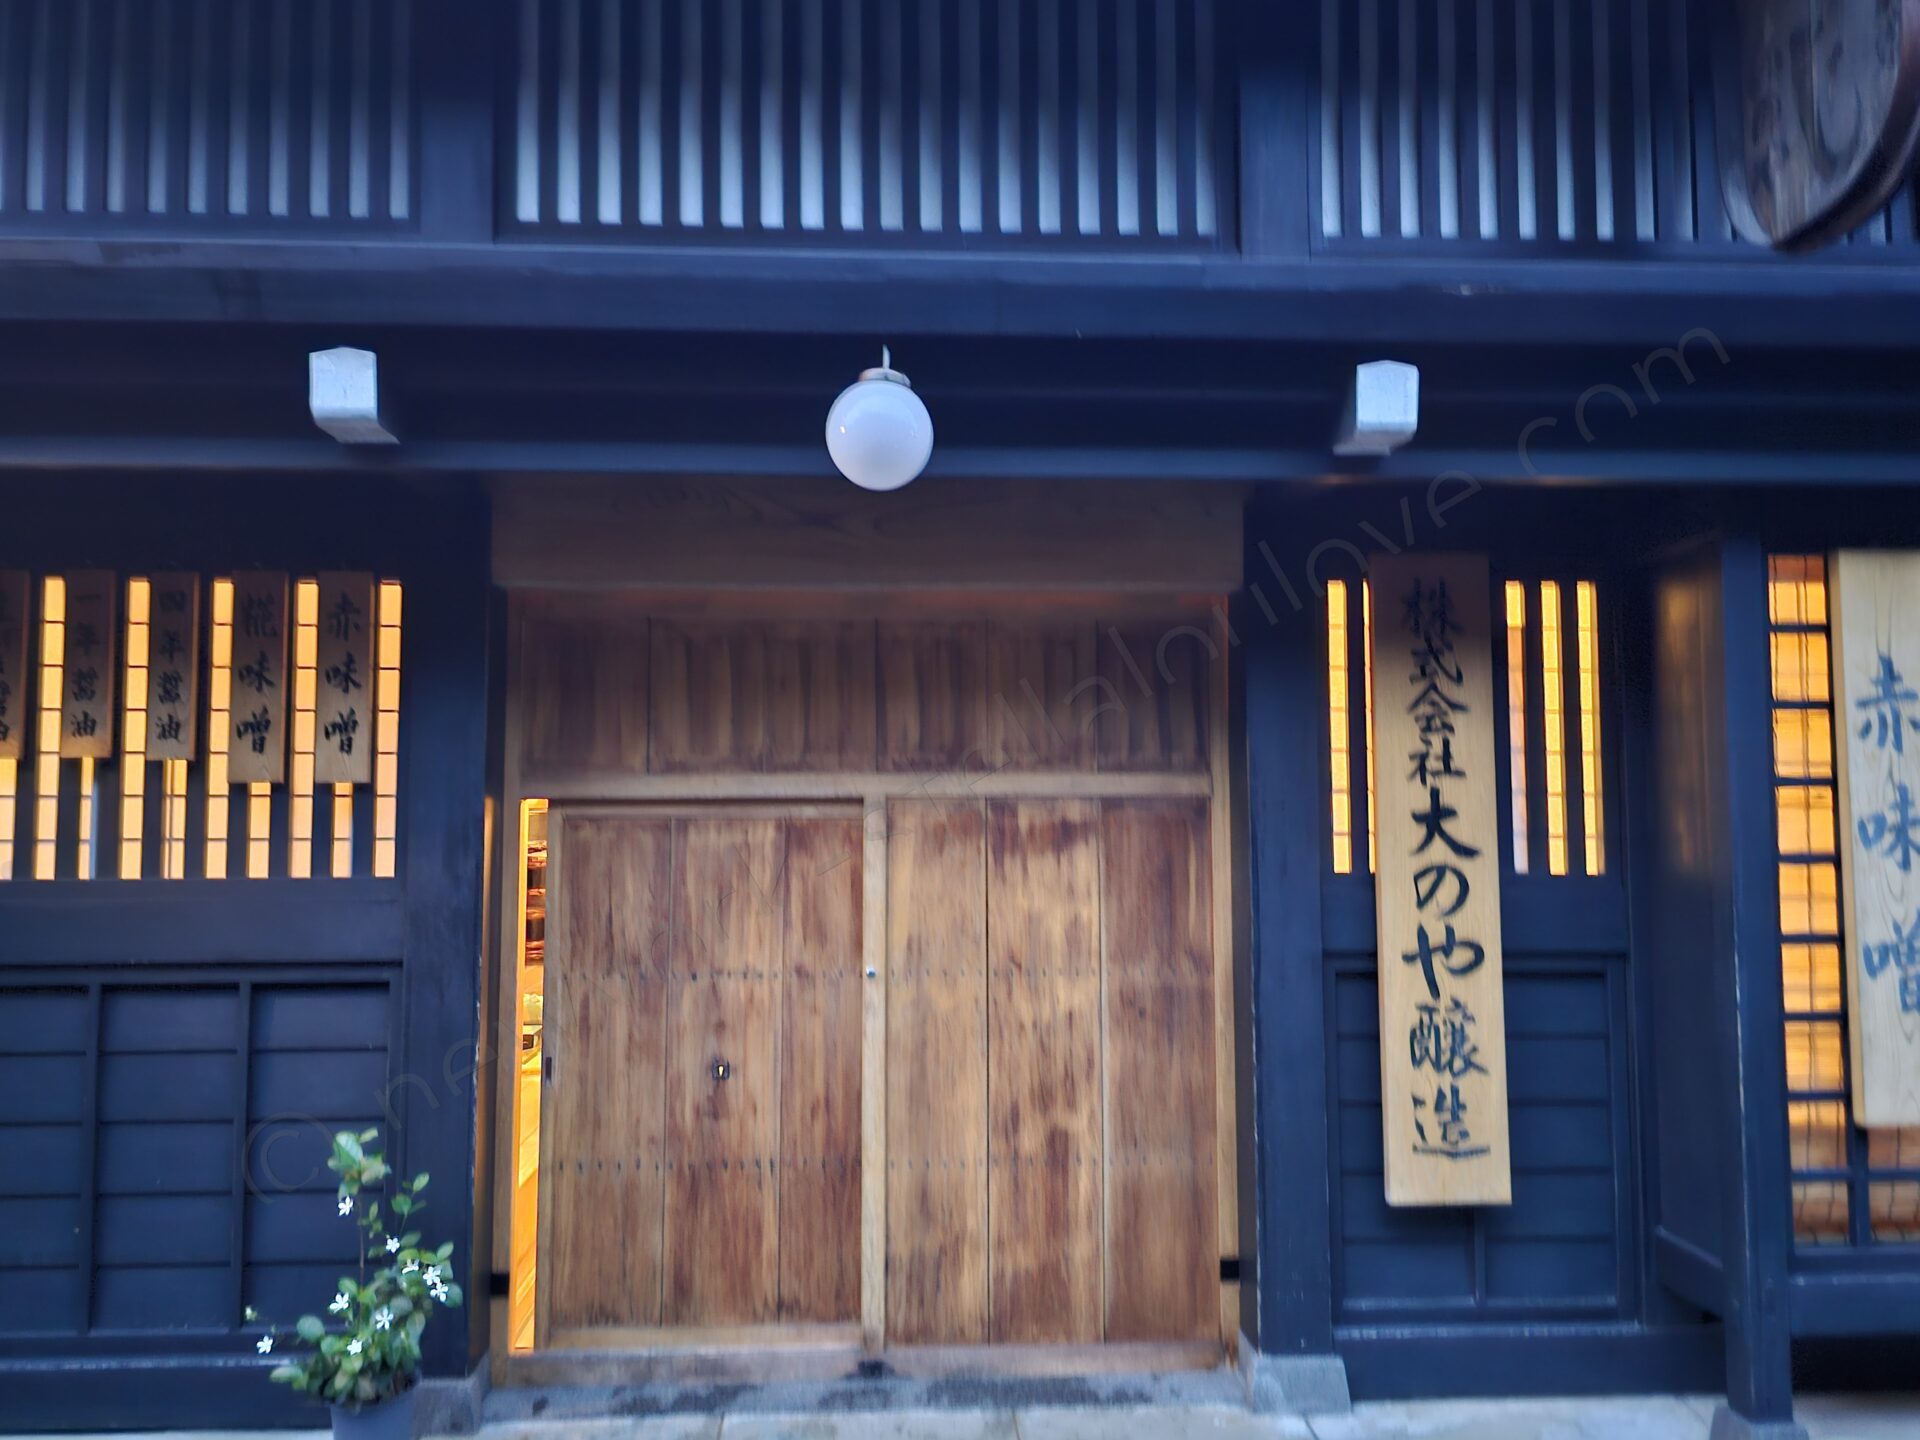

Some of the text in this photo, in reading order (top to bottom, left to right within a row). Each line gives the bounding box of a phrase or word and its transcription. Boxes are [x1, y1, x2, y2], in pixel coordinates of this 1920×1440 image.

[325, 592, 362, 754] 赤味噌
[1856, 653, 1920, 1014] 赤味噌
[1401, 576, 1491, 1161] 株式会社大のや醸造
